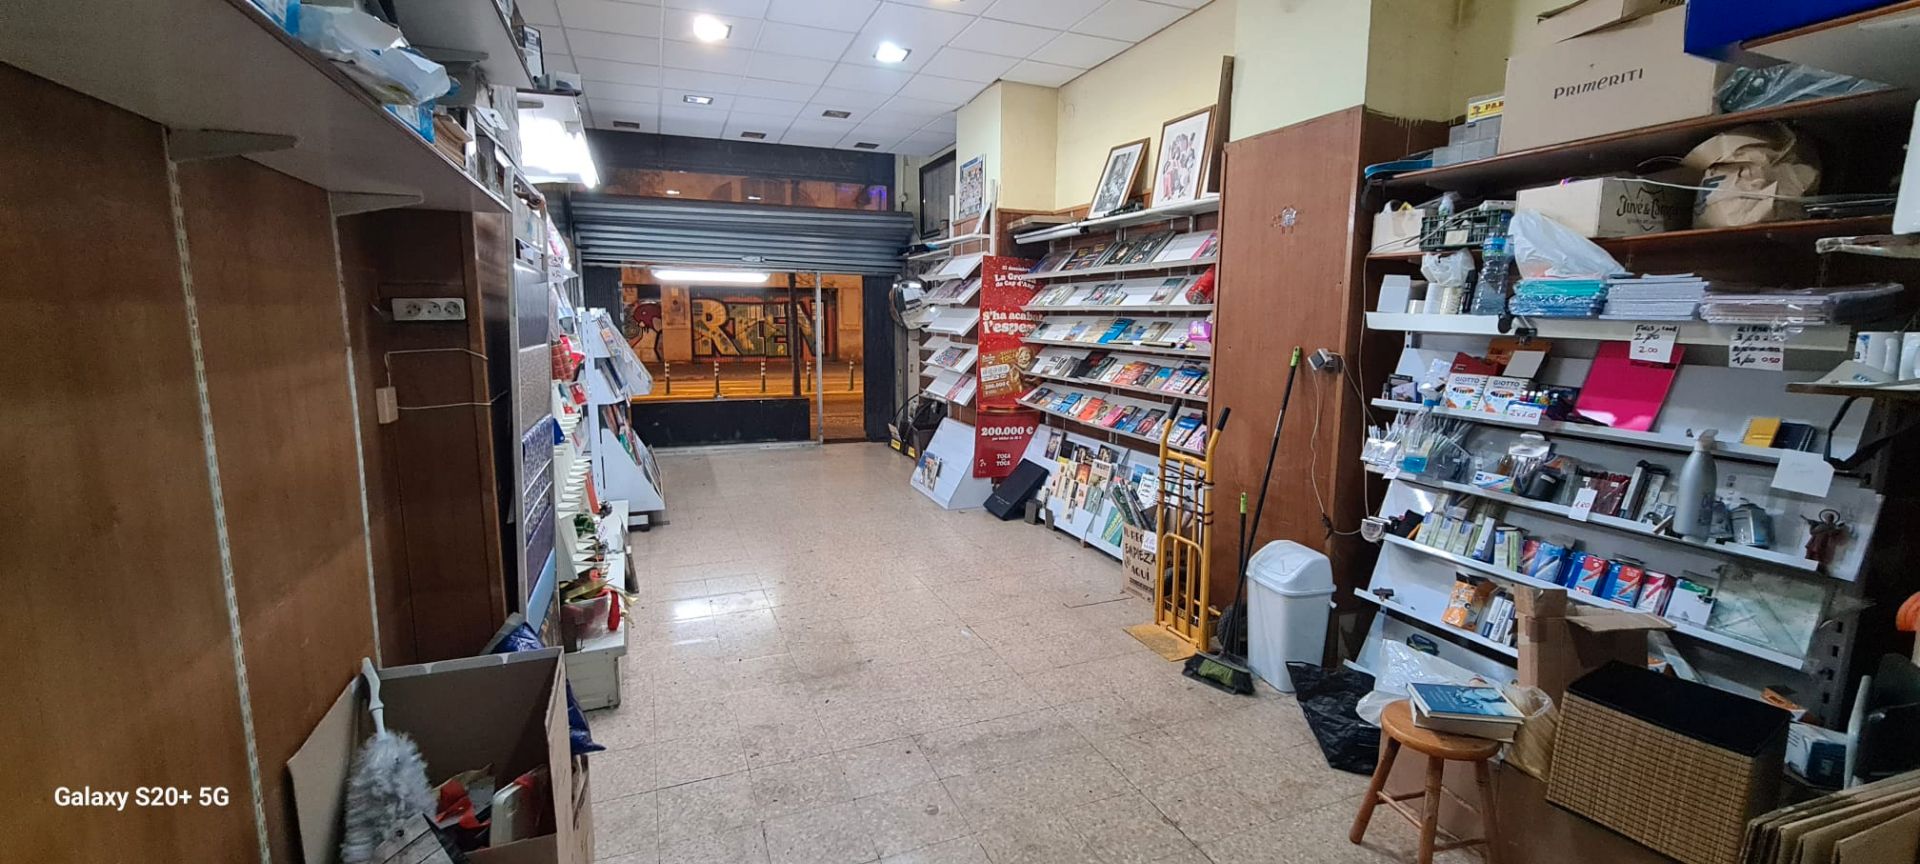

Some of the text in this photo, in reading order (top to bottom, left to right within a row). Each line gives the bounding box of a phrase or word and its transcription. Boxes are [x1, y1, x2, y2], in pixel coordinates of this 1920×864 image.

[994, 273, 1006, 282] La
[1454, 376, 1480, 384] GIOTTO
[981, 426, 1034, 436] 200.000 €
